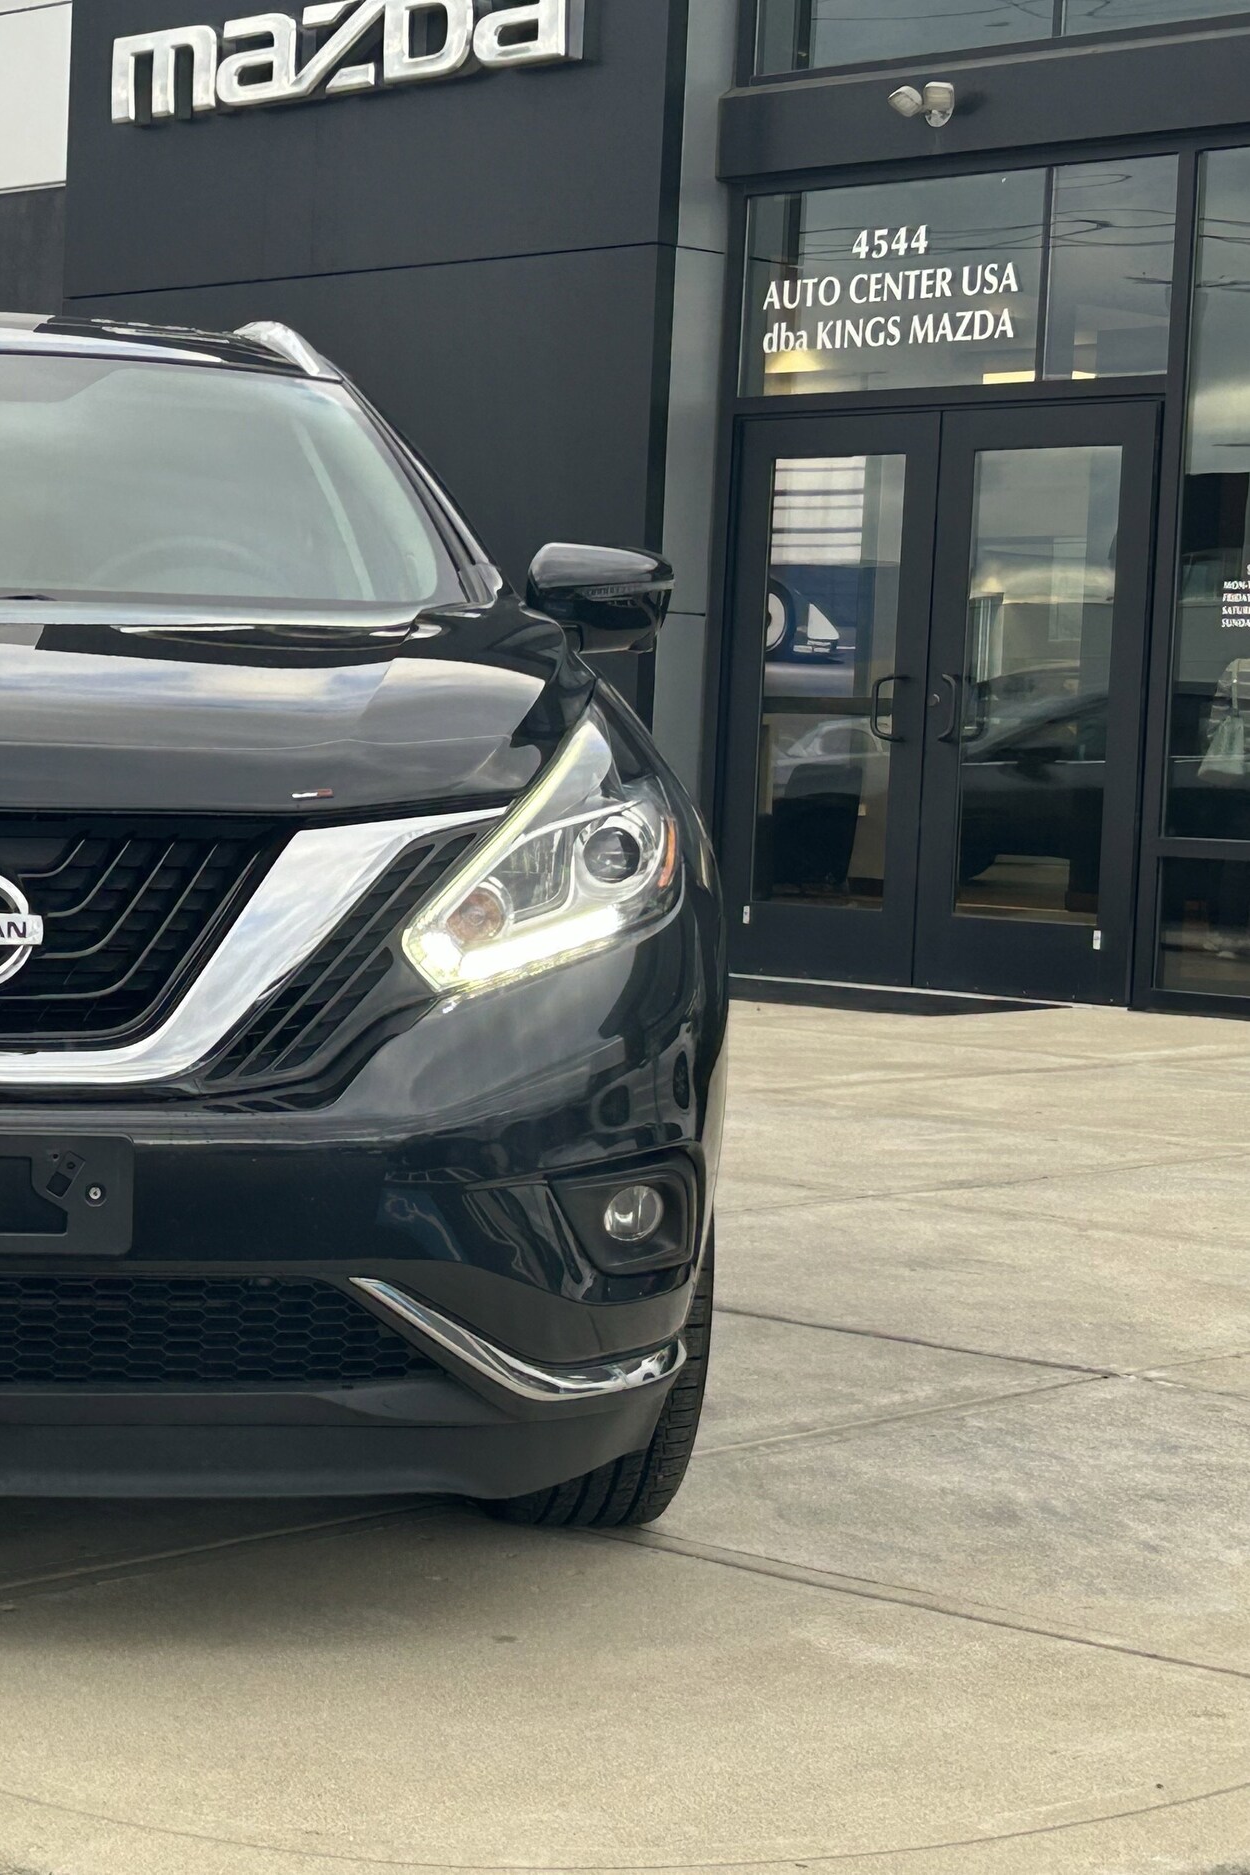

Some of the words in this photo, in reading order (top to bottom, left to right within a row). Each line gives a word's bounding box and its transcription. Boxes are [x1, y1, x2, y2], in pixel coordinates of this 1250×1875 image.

[851, 224, 929, 260] 4544
[762, 275, 841, 311] AUTO
[849, 267, 953, 304] CENTER
[961, 261, 1019, 296] USA
[762, 321, 808, 353] dba
[816, 315, 901, 350] KINGS
[908, 307, 1015, 345] MAZDA
